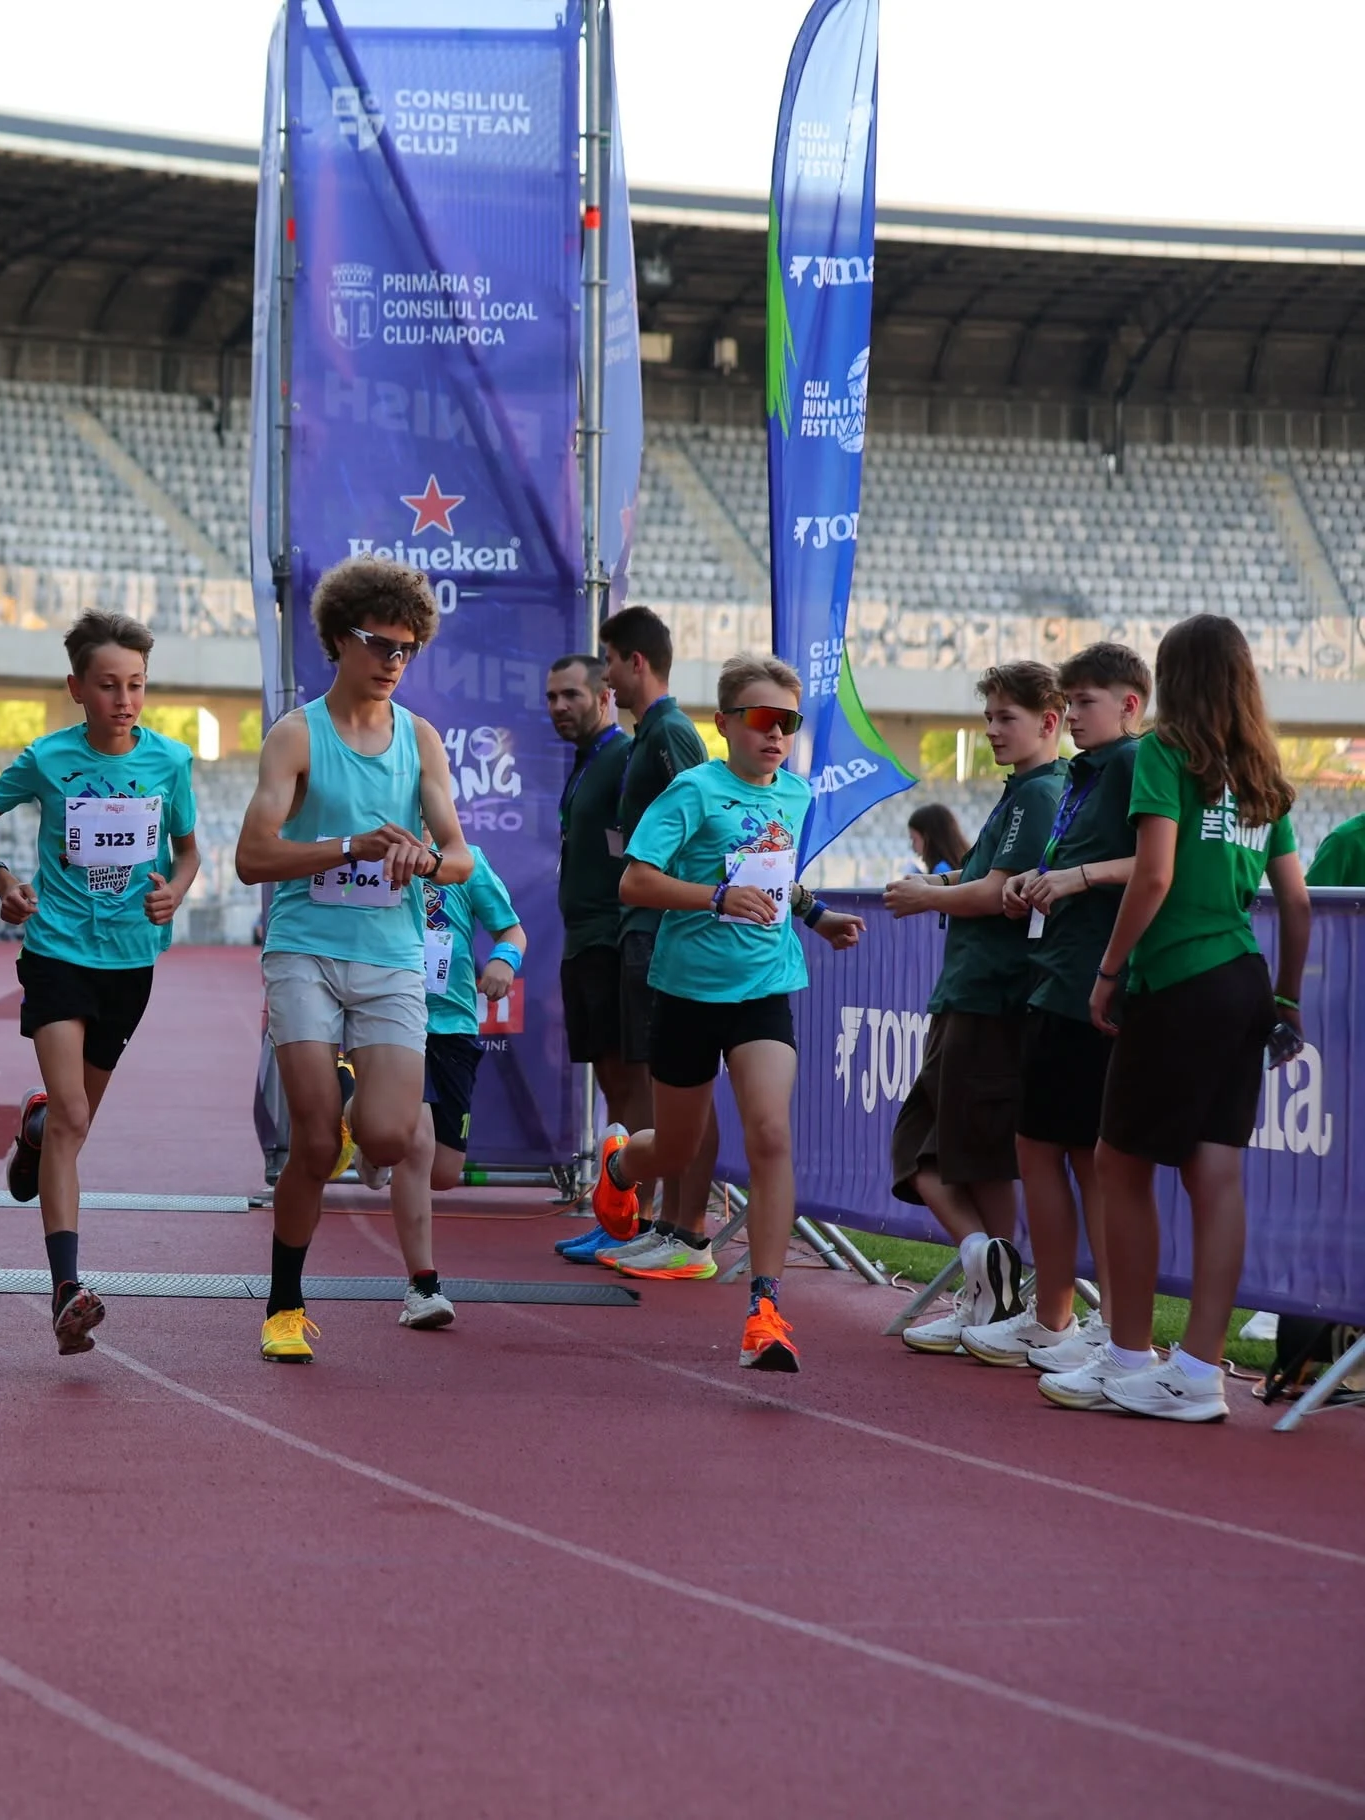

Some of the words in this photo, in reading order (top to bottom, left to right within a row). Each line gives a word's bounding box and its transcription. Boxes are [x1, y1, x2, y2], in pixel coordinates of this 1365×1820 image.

[395, 89, 530, 111] CONSILIUL
[395, 134, 458, 155] CLUJ
[383, 270, 469, 293] PRIMĂRIA
[383, 299, 476, 320] CONSILIUL
[480, 302, 538, 321] LOCAL
[383, 325, 505, 346] CLUJ-NAPOCA
[803, 380, 830, 399] CLUJ
[801, 397, 867, 417] RUNNIN
[1200, 808, 1223, 841] THE
[94, 832, 135, 847] 3123
[89, 866, 110, 878] CLUJ
[89, 870, 131, 884] RUNNING
